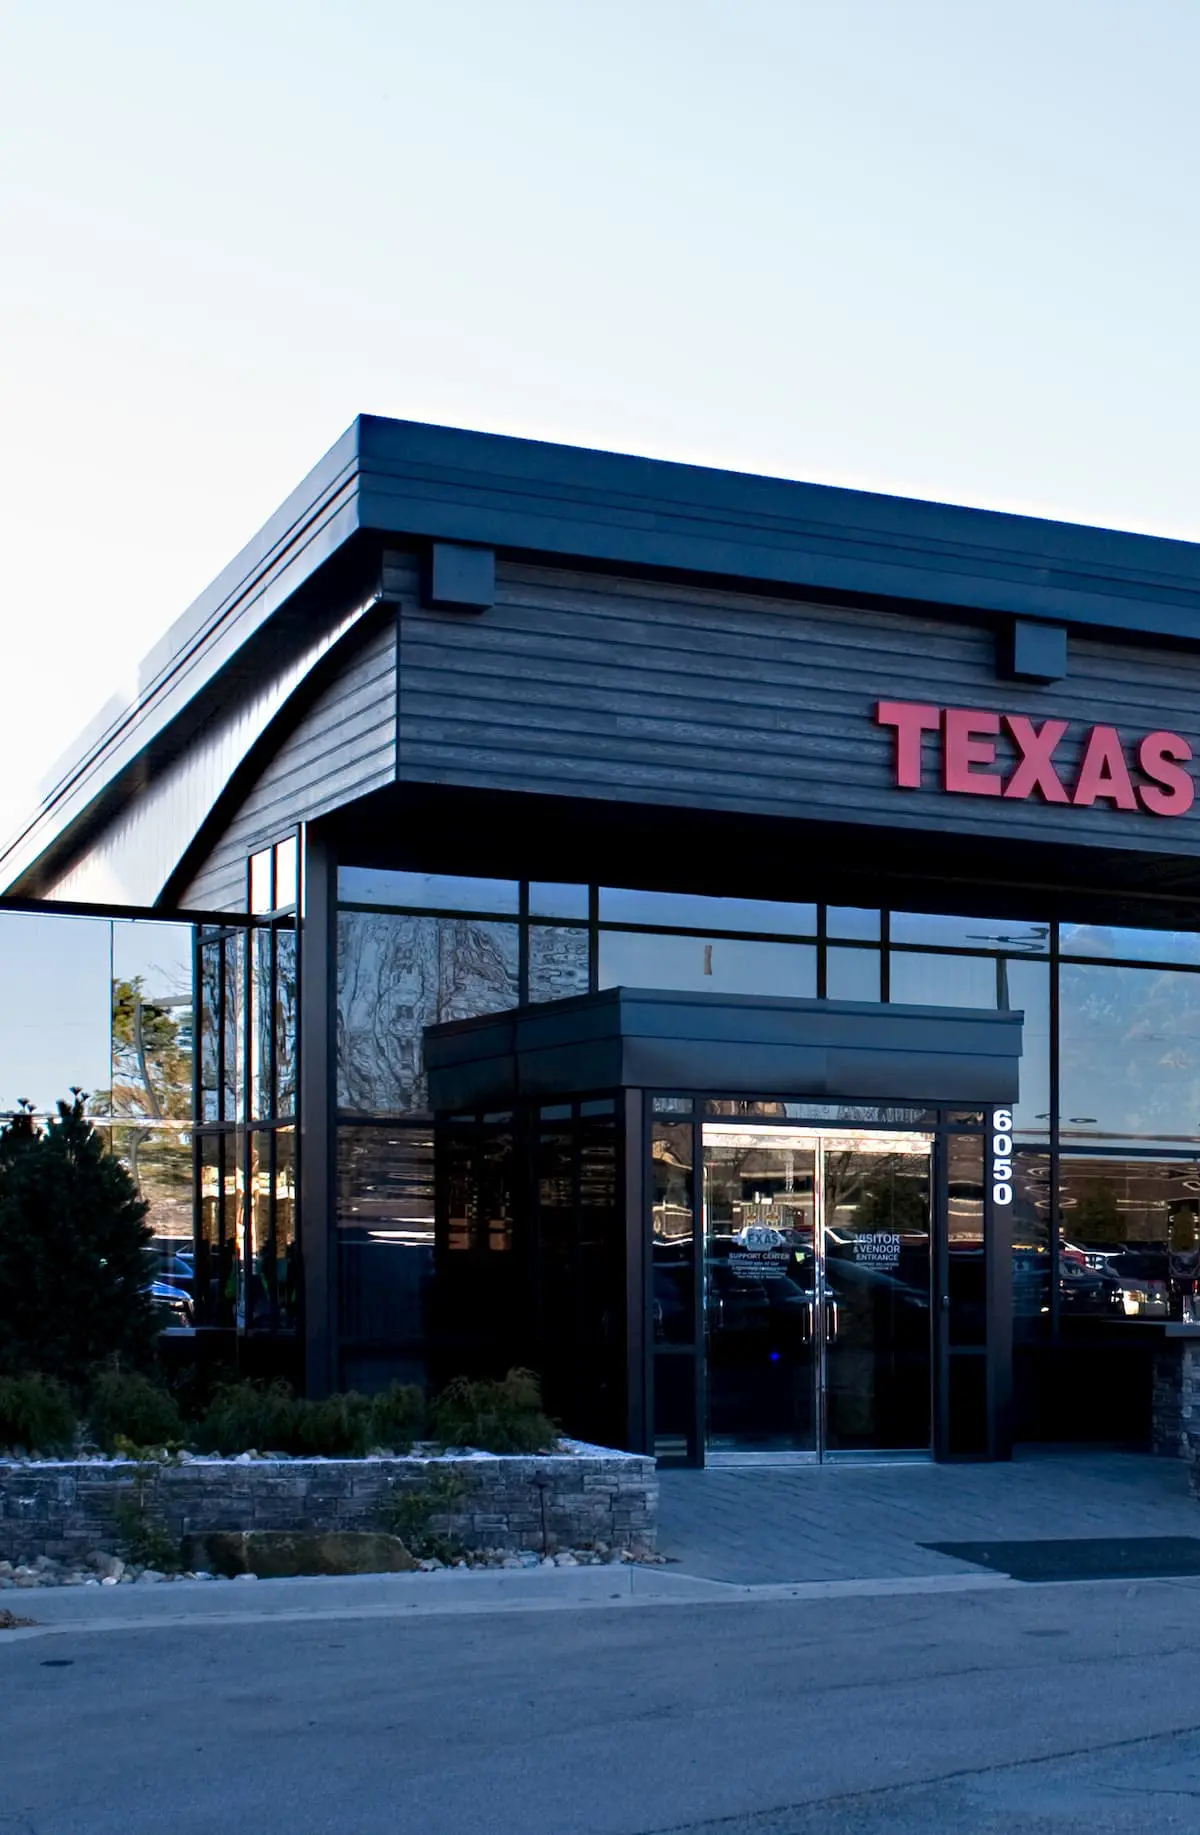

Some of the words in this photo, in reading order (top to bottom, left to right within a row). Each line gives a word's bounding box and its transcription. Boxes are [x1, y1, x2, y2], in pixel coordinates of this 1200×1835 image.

[875, 699, 1195, 818] TEXAS
[993, 1109, 1013, 1206] 6050
[742, 1233, 779, 1246] EXAS
[855, 1233, 900, 1245] VISITOR
[860, 1244, 901, 1254] VENDOR
[728, 1252, 761, 1260] SUPPORT
[762, 1252, 790, 1260] CENTER
[856, 1253, 898, 1261] ENTRANCE
